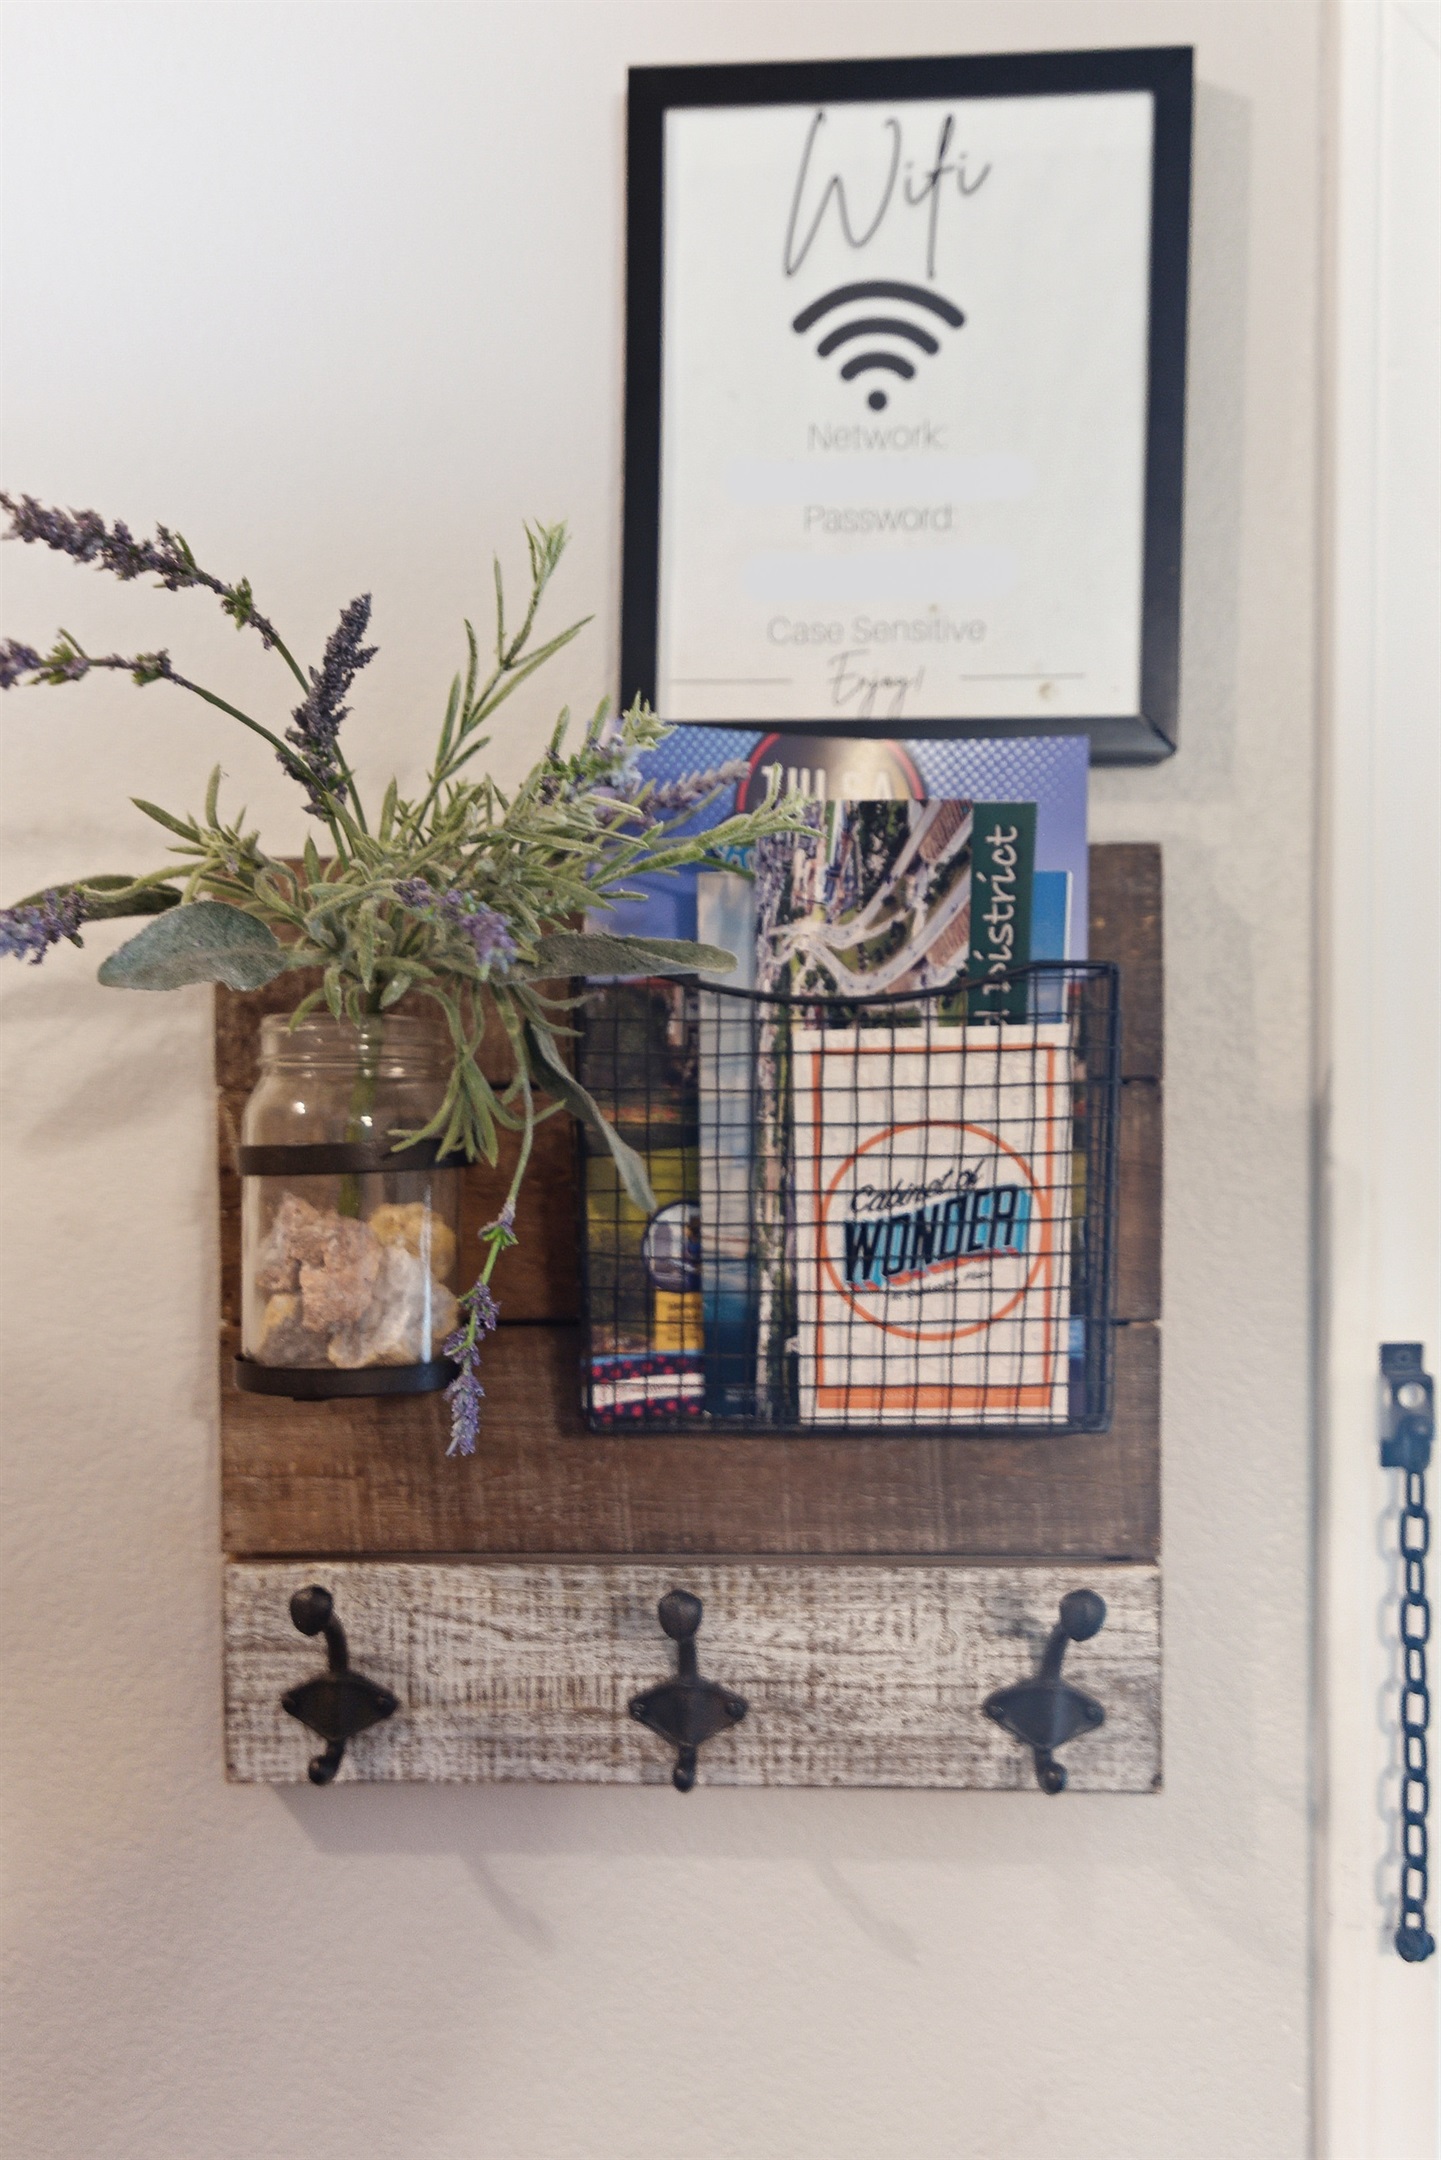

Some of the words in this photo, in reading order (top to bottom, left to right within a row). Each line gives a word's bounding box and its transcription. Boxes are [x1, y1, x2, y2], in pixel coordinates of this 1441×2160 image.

[784, 111, 991, 279] Wifi
[766, 615, 845, 645] Case
[851, 614, 987, 643] Sensitive
[845, 1185, 1029, 1283] WONDER
